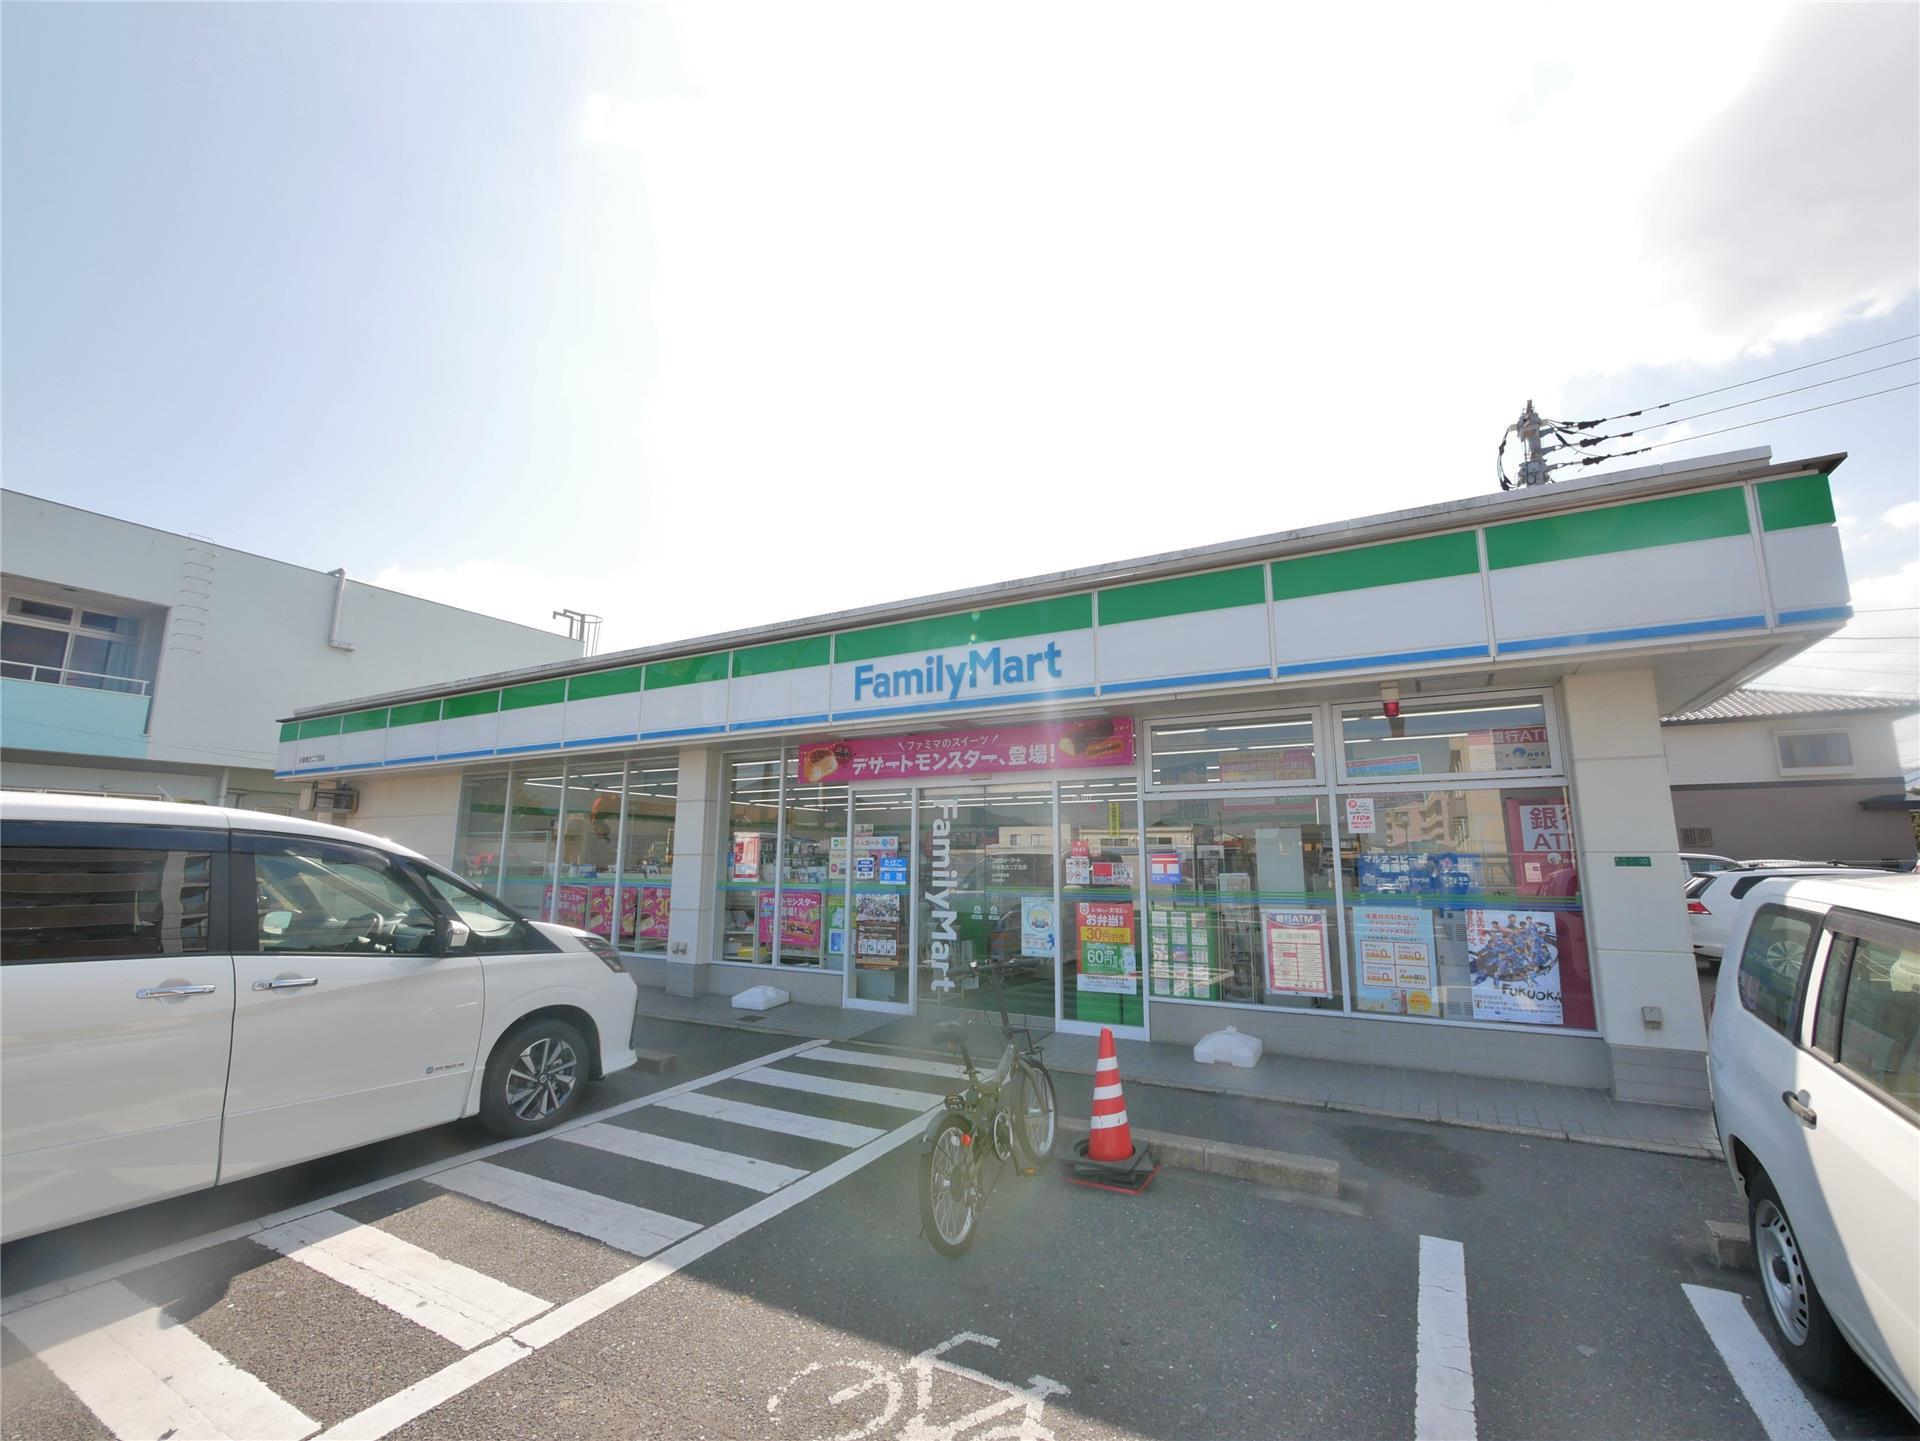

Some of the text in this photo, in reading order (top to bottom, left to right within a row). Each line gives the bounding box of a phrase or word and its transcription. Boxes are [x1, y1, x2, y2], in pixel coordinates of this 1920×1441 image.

[854, 641, 1062, 700] FamilyMart
[907, 736, 989, 750] ファミマのスイーツ
[925, 798, 958, 993] FamilyMart
[1501, 983, 1563, 1004] FUKUOKA
